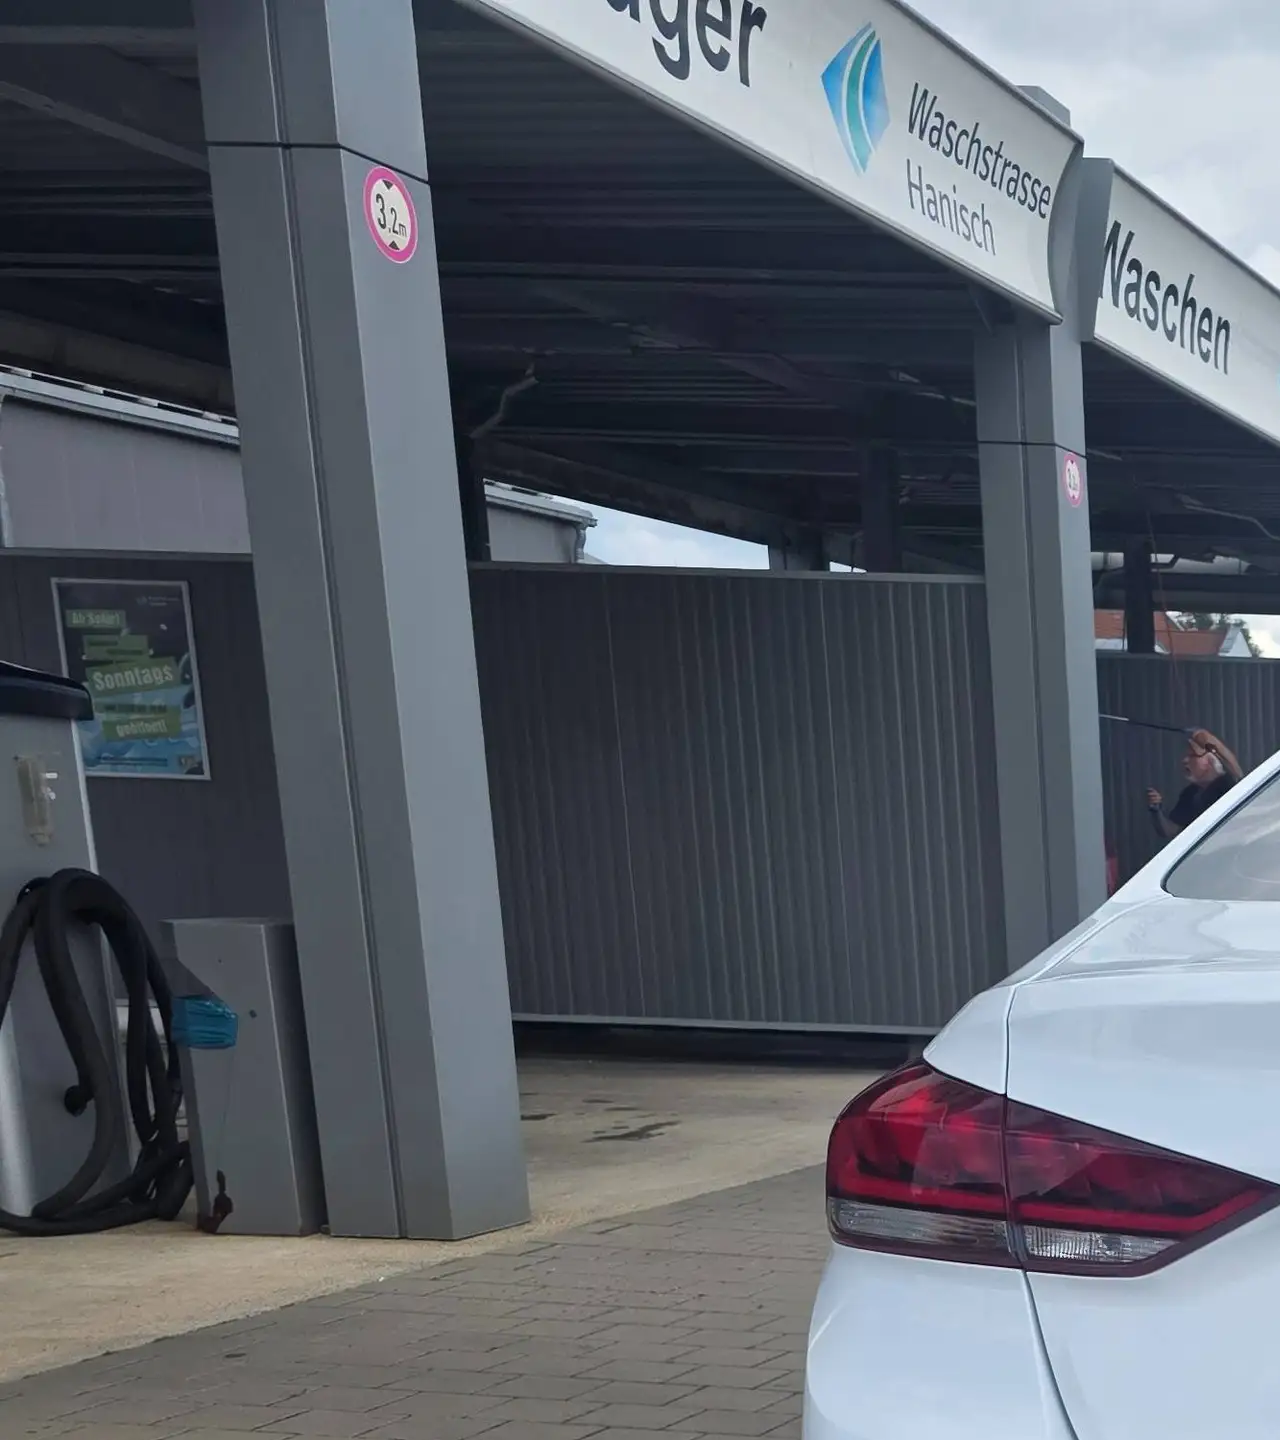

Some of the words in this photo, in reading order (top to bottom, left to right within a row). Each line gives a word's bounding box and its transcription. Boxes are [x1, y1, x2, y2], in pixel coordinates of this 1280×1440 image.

[606, 0, 767, 87] ger
[908, 82, 1051, 219] Waschstrasse
[906, 158, 996, 256] Hanisch
[93, 664, 174, 691] Sonntags
